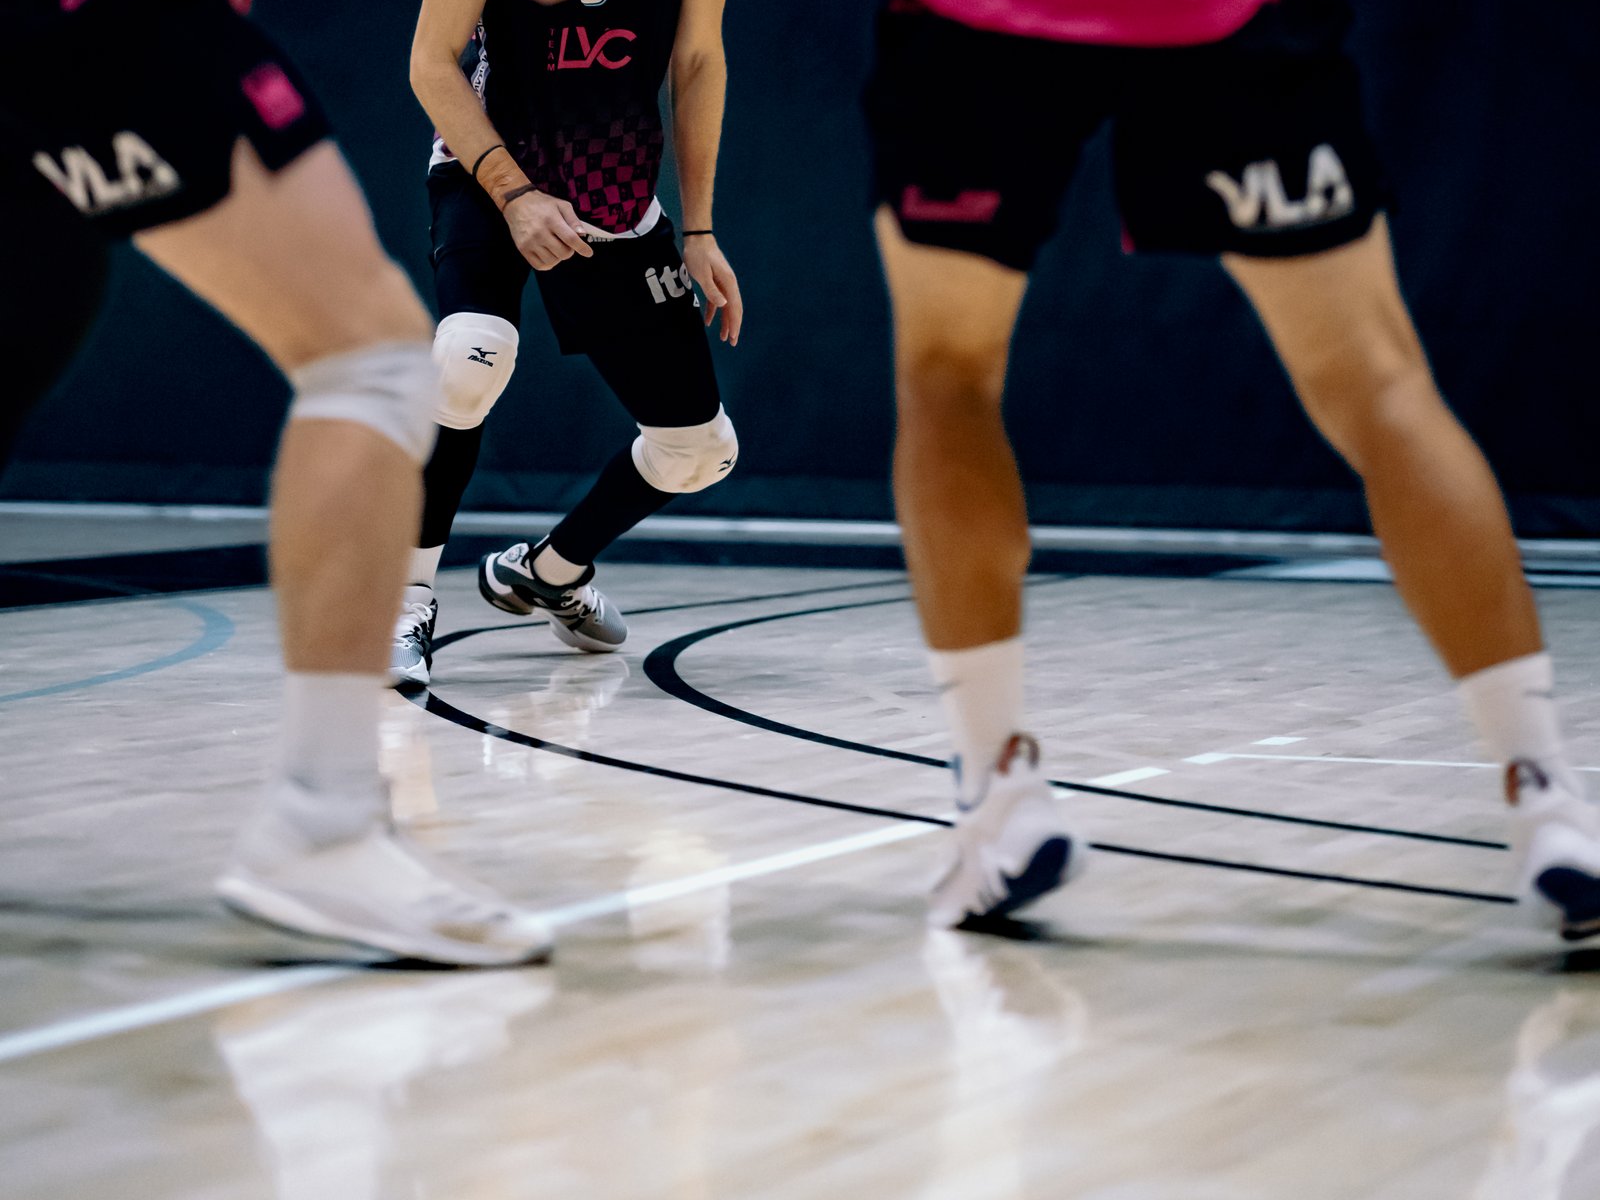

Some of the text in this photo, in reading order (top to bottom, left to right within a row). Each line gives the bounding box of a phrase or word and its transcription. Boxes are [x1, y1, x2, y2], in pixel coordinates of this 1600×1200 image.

[547, 27, 555, 71] TEAM
[557, 26, 638, 70] LVC
[32, 130, 180, 214] VLA
[1205, 143, 1354, 229] VLA
